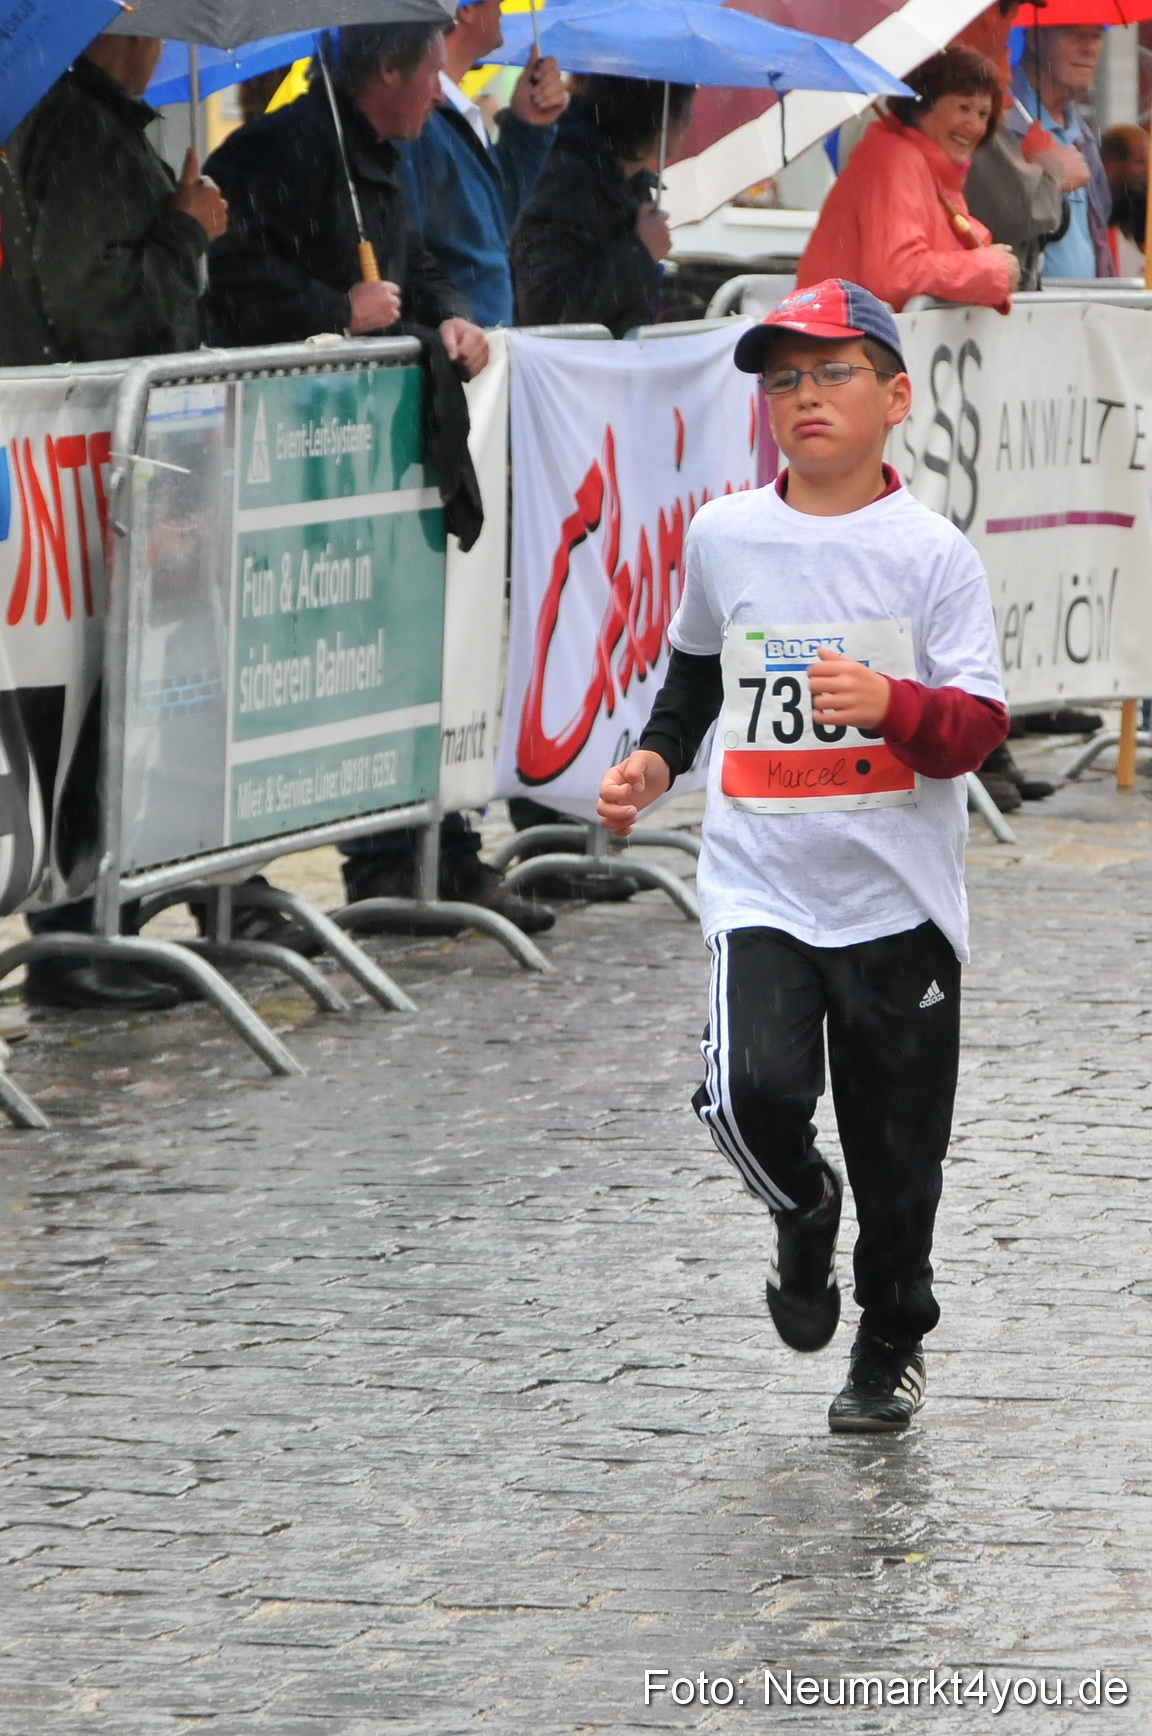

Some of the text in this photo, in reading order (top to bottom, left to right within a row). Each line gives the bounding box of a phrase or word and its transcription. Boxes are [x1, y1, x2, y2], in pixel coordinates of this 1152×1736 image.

[995, 384, 1147, 471] ANWÄLTE
[243, 538, 372, 618] Fun & Action in
[239, 627, 384, 714] sicheren Bahnen!
[440, 709, 486, 766] markt
[738, 676, 886, 745] 73
[767, 757, 848, 789] Marcel
[918, 991, 945, 1009] adidas
